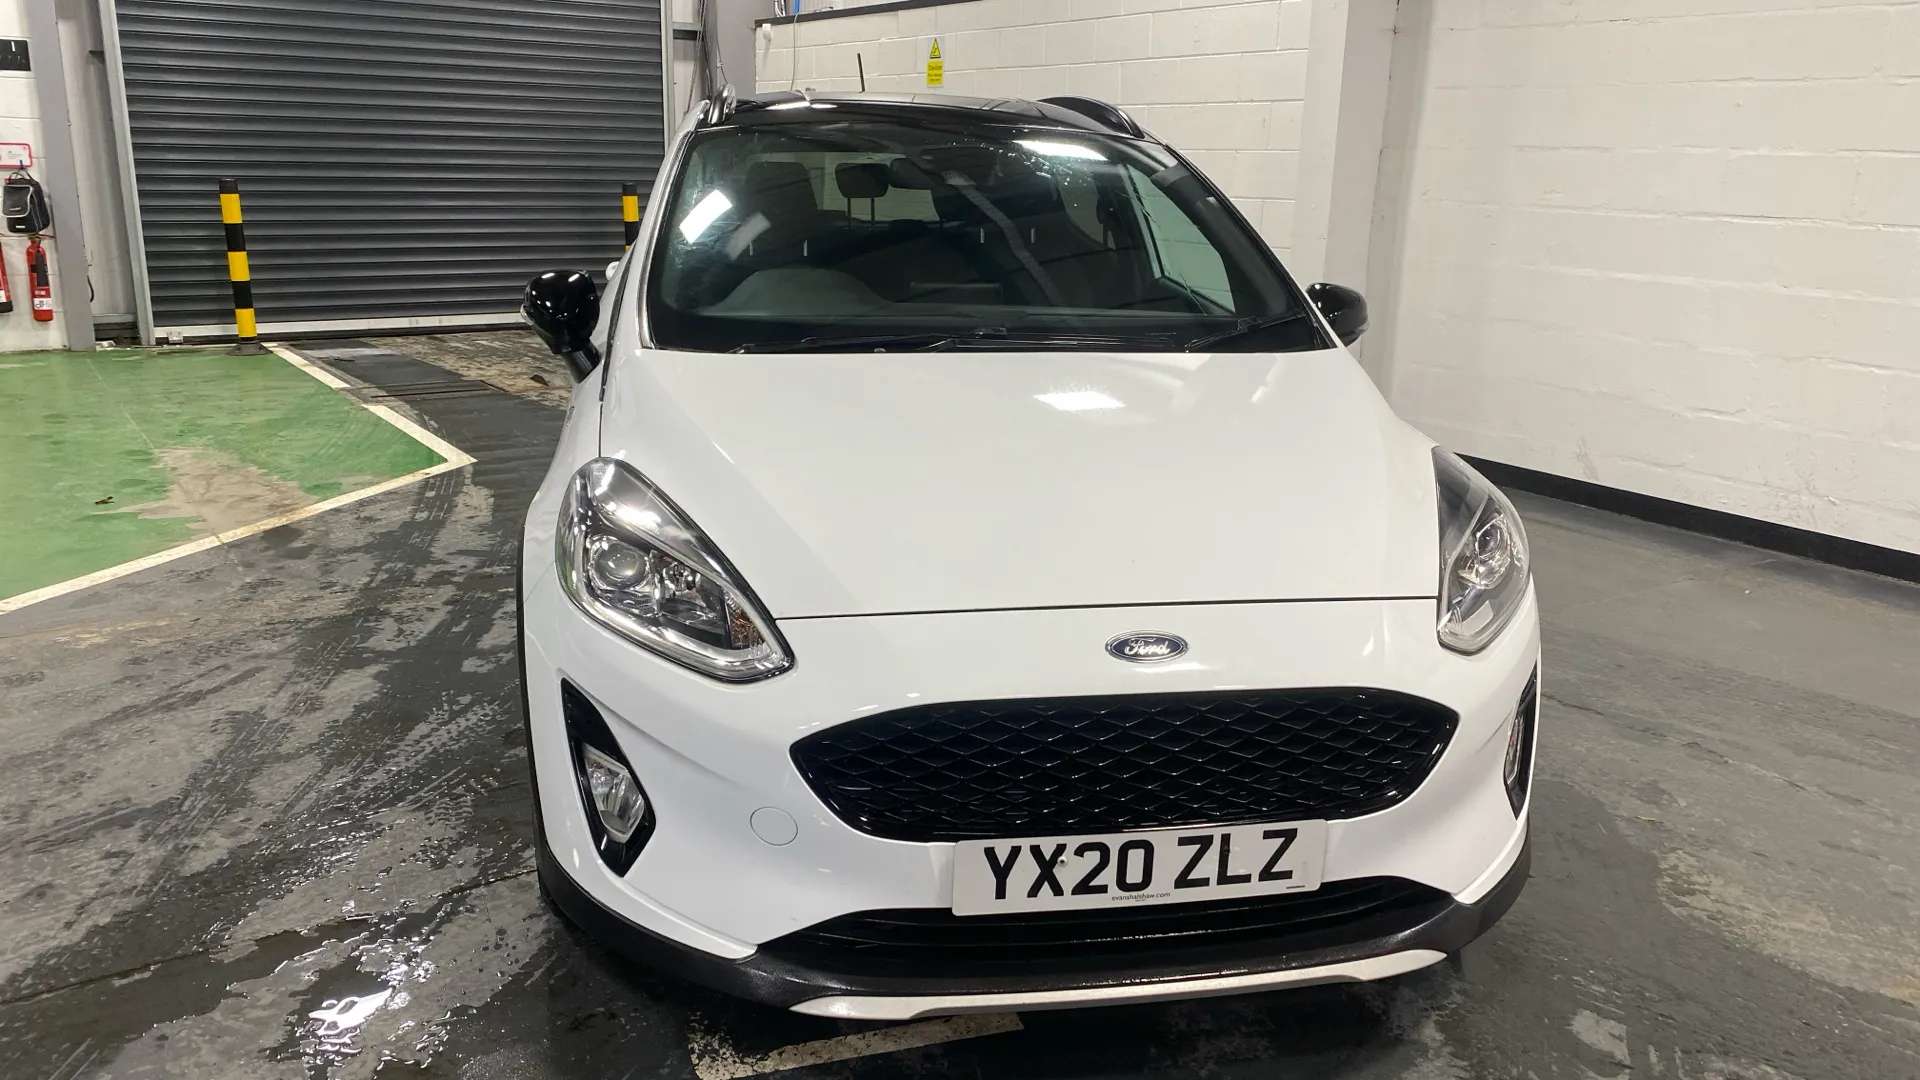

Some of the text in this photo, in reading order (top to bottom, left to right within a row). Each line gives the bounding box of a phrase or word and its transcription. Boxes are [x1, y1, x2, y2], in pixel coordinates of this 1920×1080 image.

[1124, 637, 1171, 655] Ford
[983, 828, 1298, 900] YX20 ZLZ
